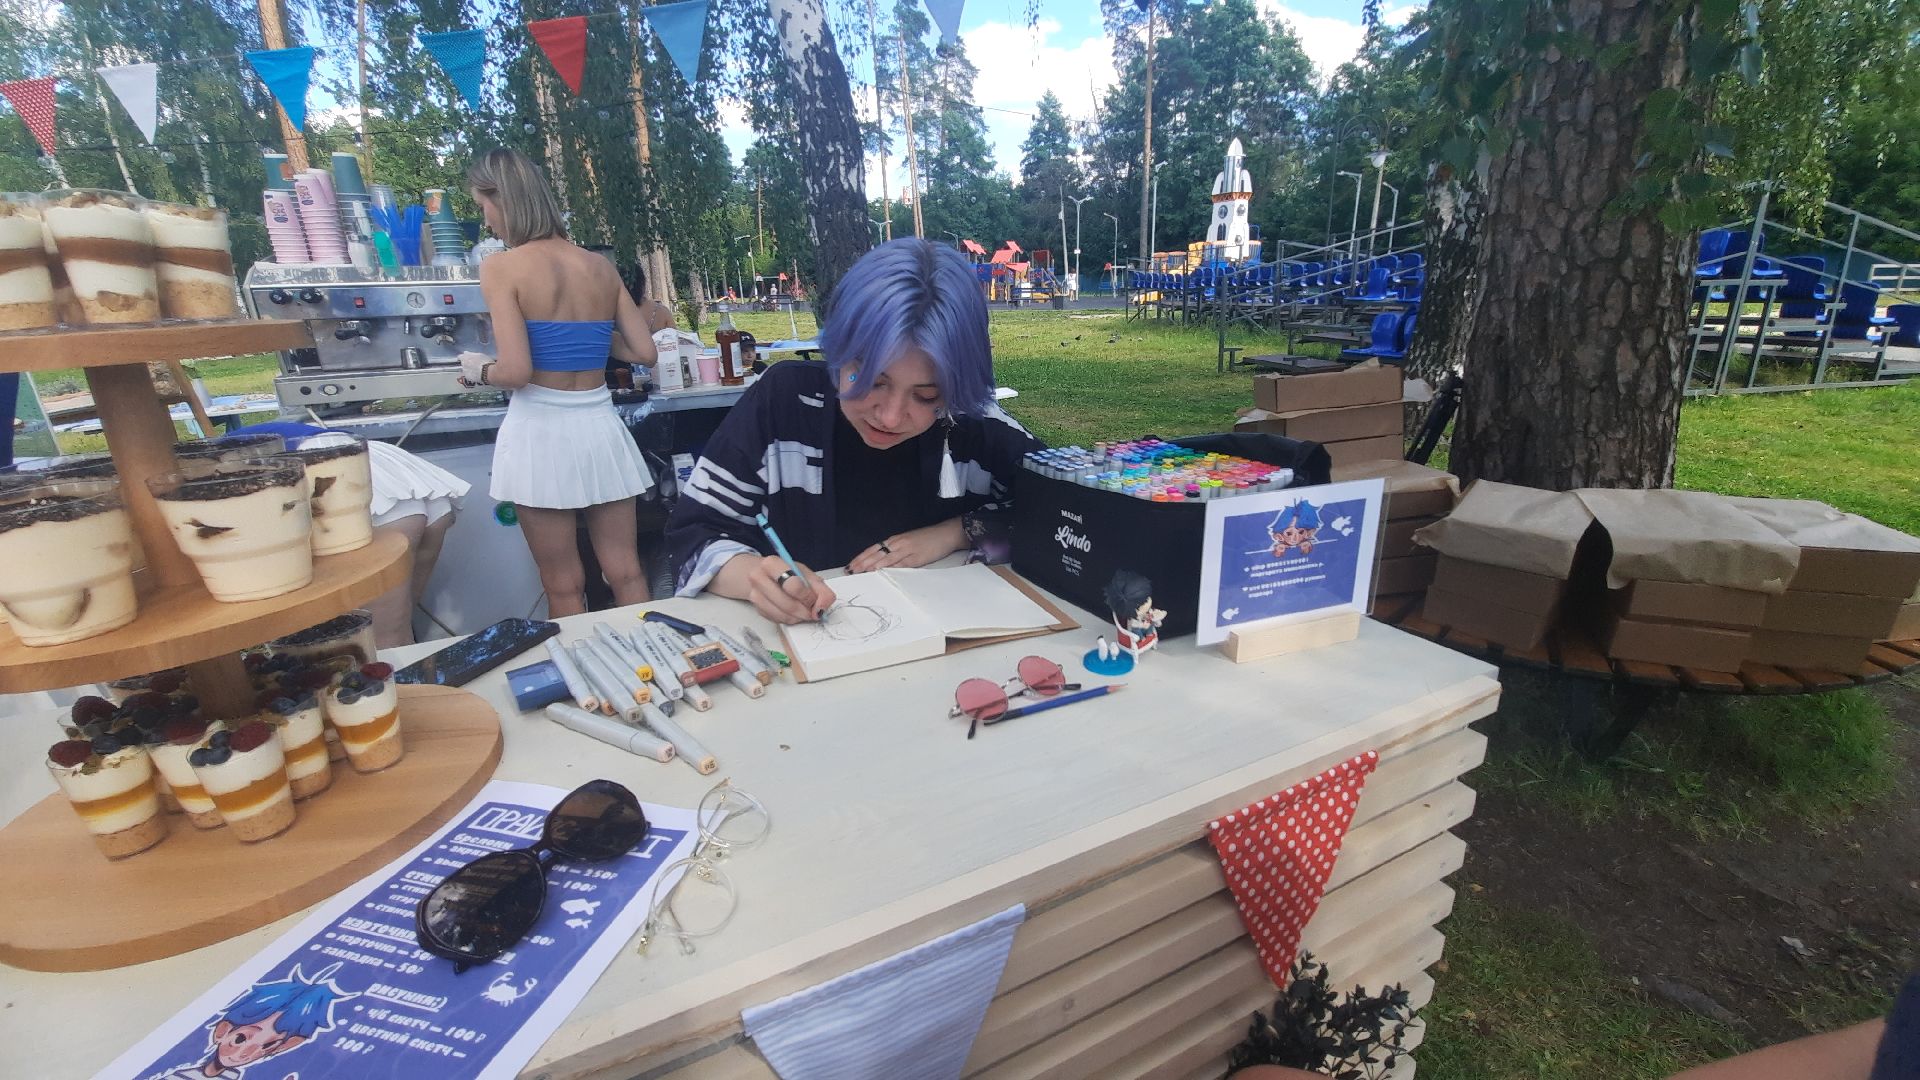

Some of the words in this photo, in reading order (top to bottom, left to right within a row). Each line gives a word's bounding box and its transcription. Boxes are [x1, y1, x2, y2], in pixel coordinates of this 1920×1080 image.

[1054, 525, 1091, 552] Lindo
[388, 1014, 430, 1030] скетч
[348, 1023, 410, 1044] цветной
[409, 1038, 454, 1056] скетч
